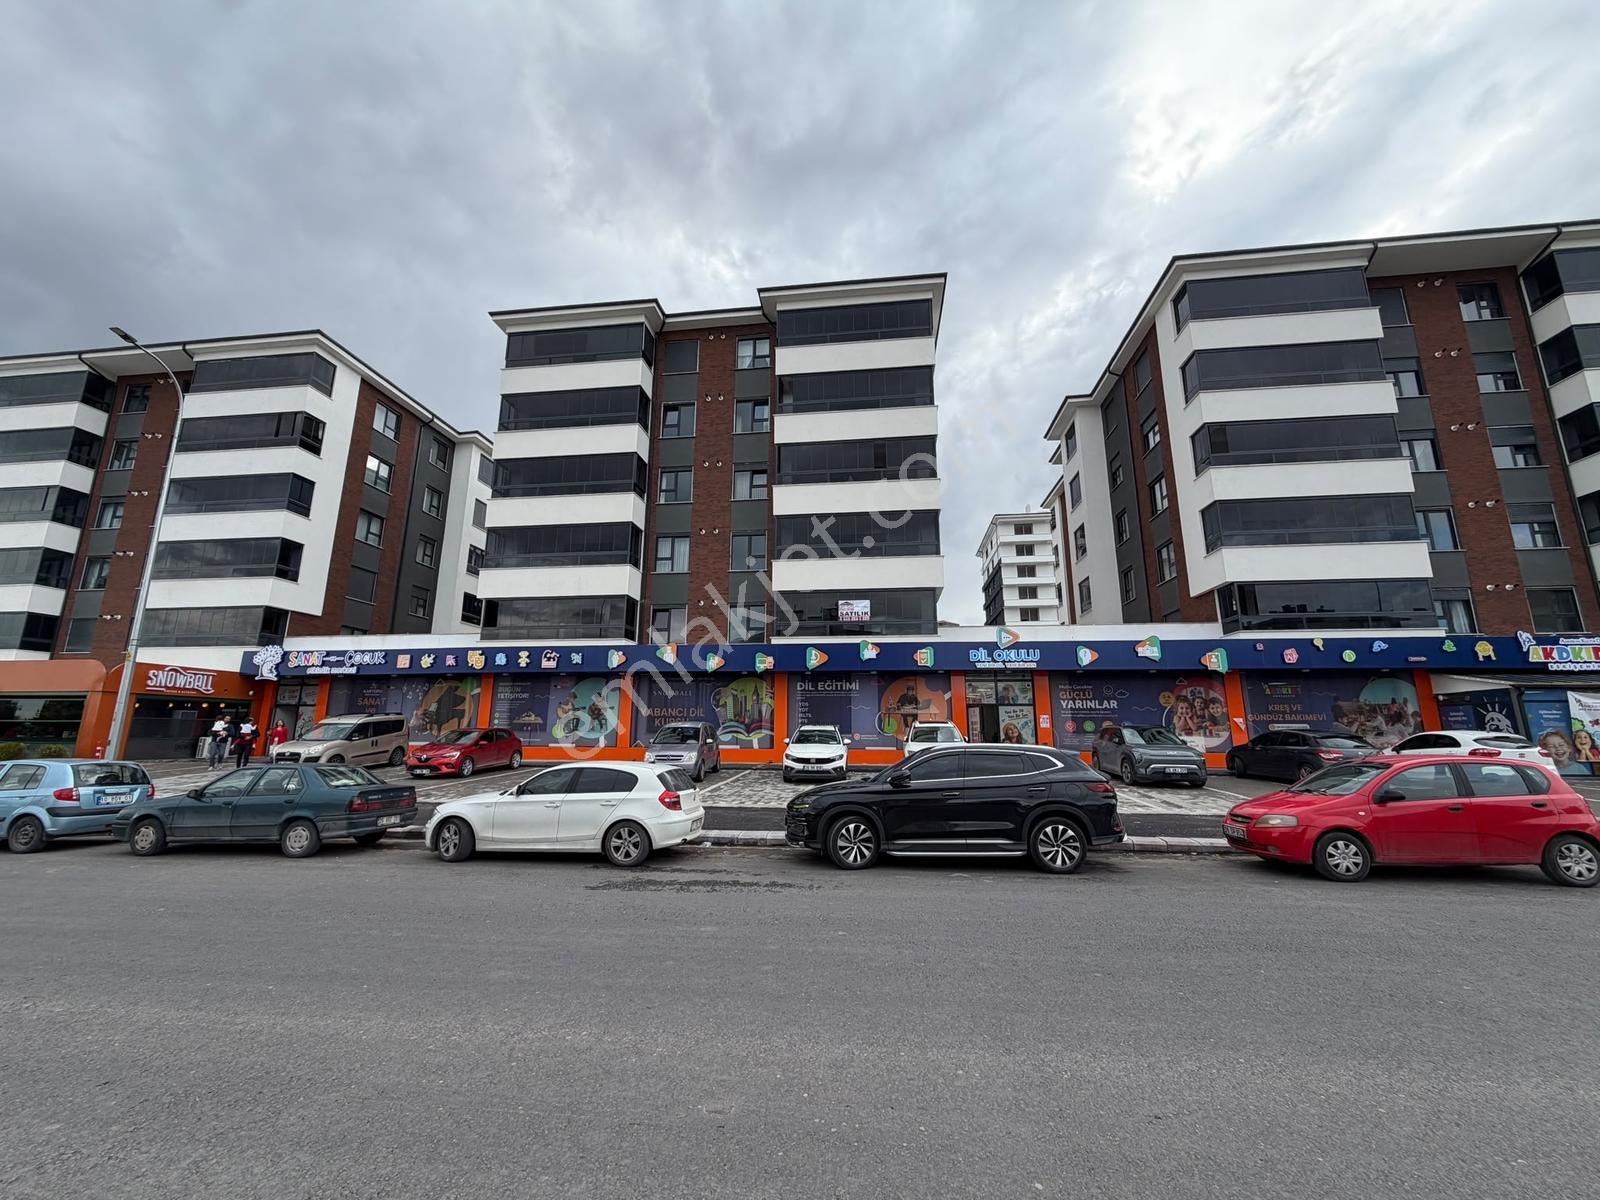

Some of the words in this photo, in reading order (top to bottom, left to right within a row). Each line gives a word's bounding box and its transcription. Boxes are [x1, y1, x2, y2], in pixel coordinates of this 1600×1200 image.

[288, 651, 326, 668] SANAT
[344, 651, 385, 667] ÇOCUK
[969, 648, 991, 661] DİL
[993, 649, 1040, 661] OKULU
[146, 670, 213, 690] SNOWBALL
[796, 680, 815, 690] DİL
[817, 680, 859, 690] EĞİTİMİ
[1060, 689, 1093, 700] GÜÇLÜ
[1061, 700, 1118, 709] YARINLAR
[1268, 704, 1290, 713] KREŞ
[689, 705, 705, 717] DİL
[1248, 713, 1284, 721] GÜNDÜZ
[1285, 713, 1327, 721] BAKIMEVİ
